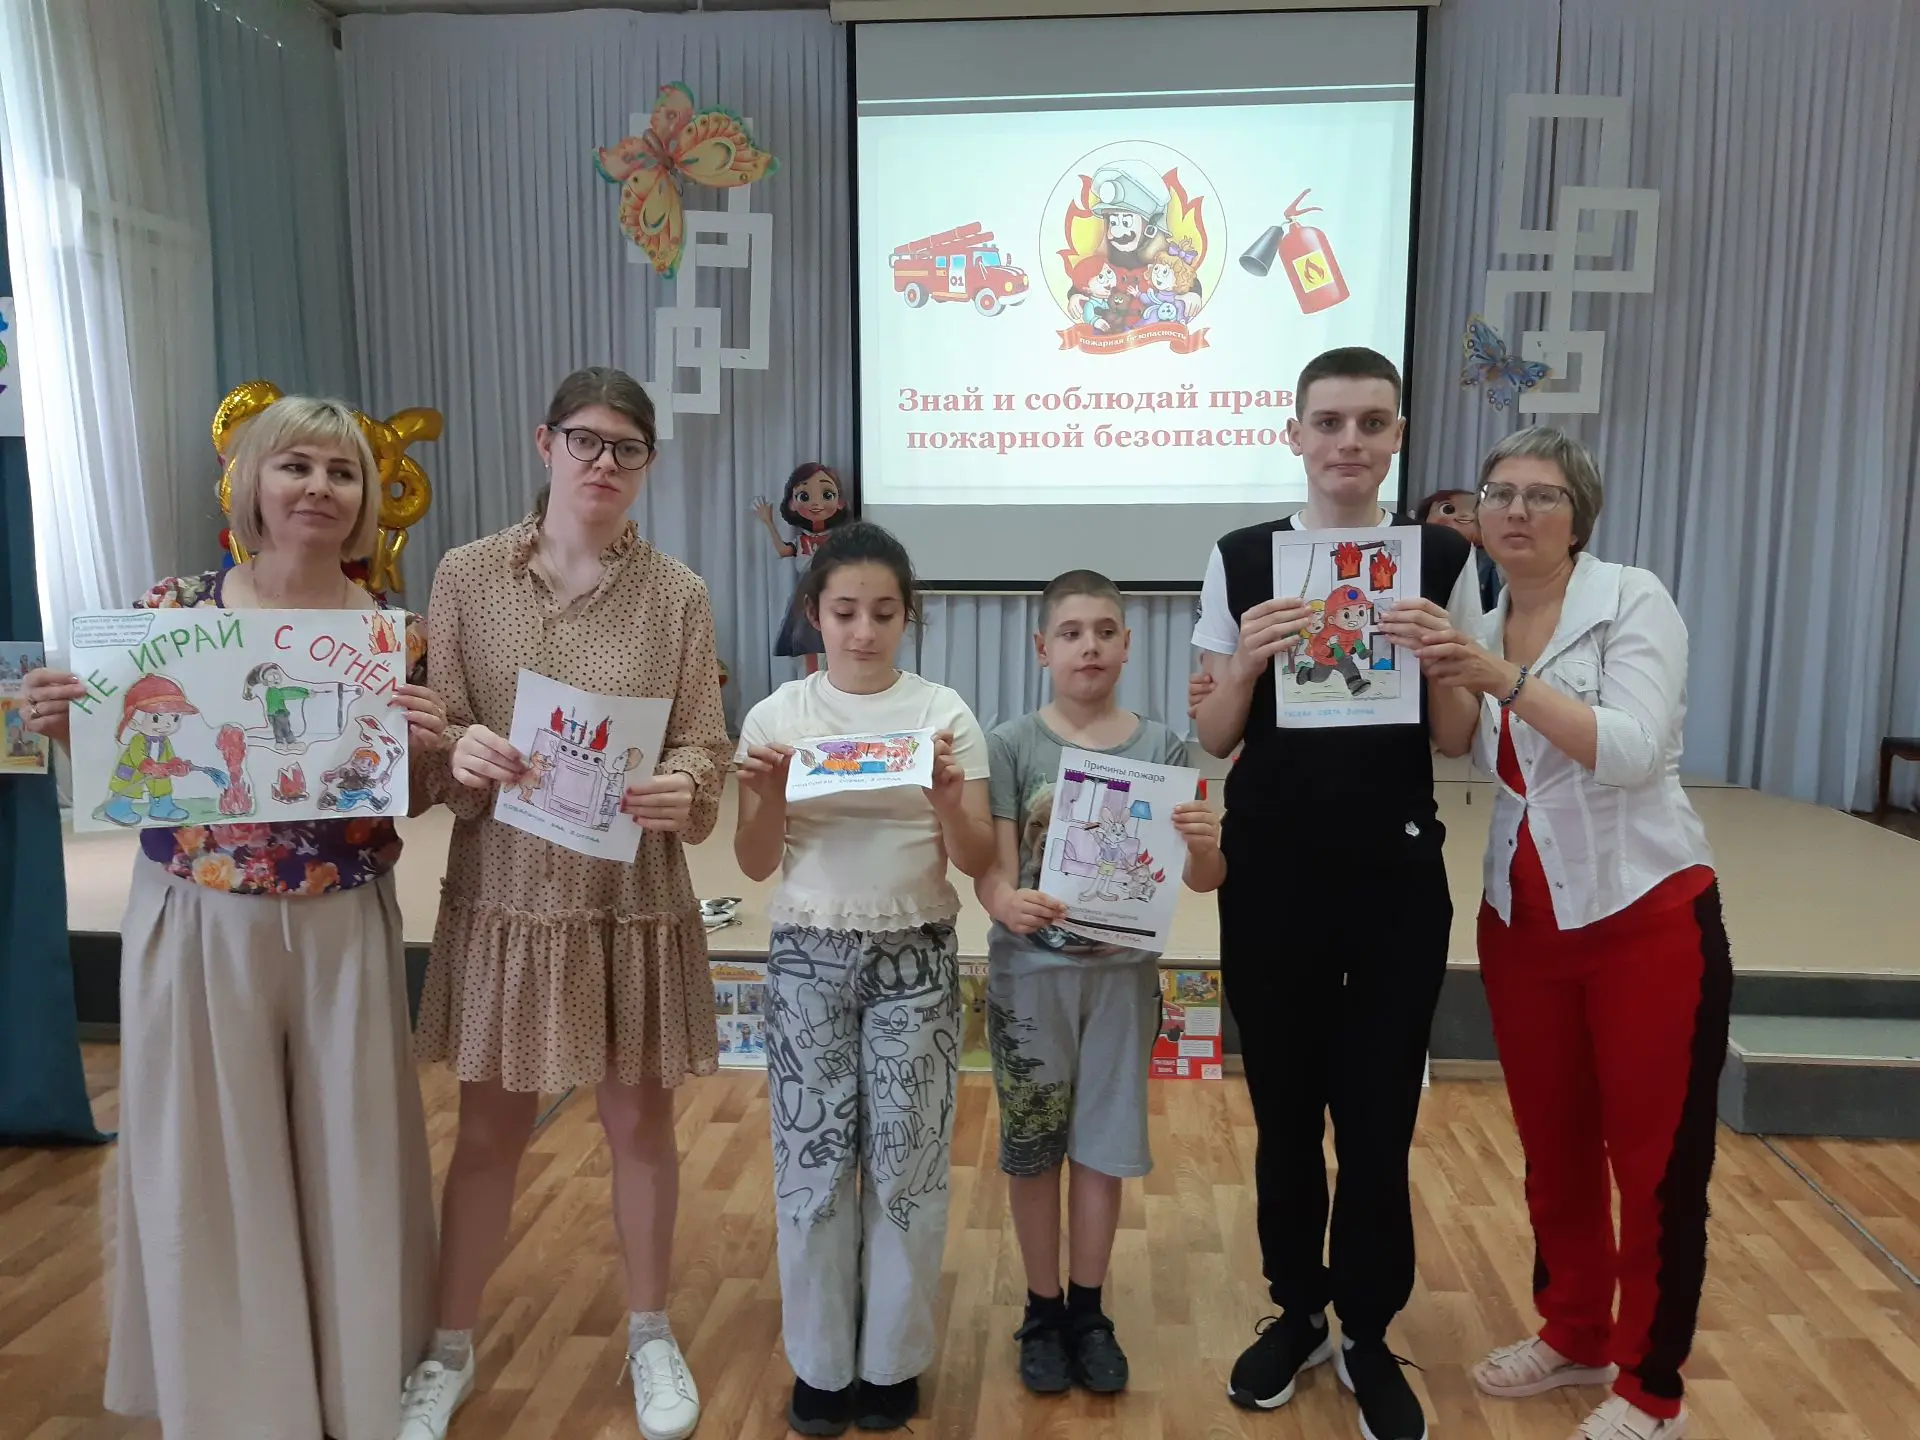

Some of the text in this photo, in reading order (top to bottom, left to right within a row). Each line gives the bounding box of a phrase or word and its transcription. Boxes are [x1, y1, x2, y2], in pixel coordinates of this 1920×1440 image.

[950, 276, 964, 286] 01
[898, 384, 1294, 414] Знай и соблюдай прав
[907, 423, 1290, 455] пожарной безопаснос
[128, 612, 243, 673] ИГРАЙ
[274, 624, 293, 650] С
[1084, 759, 1165, 783] Причины пожара
